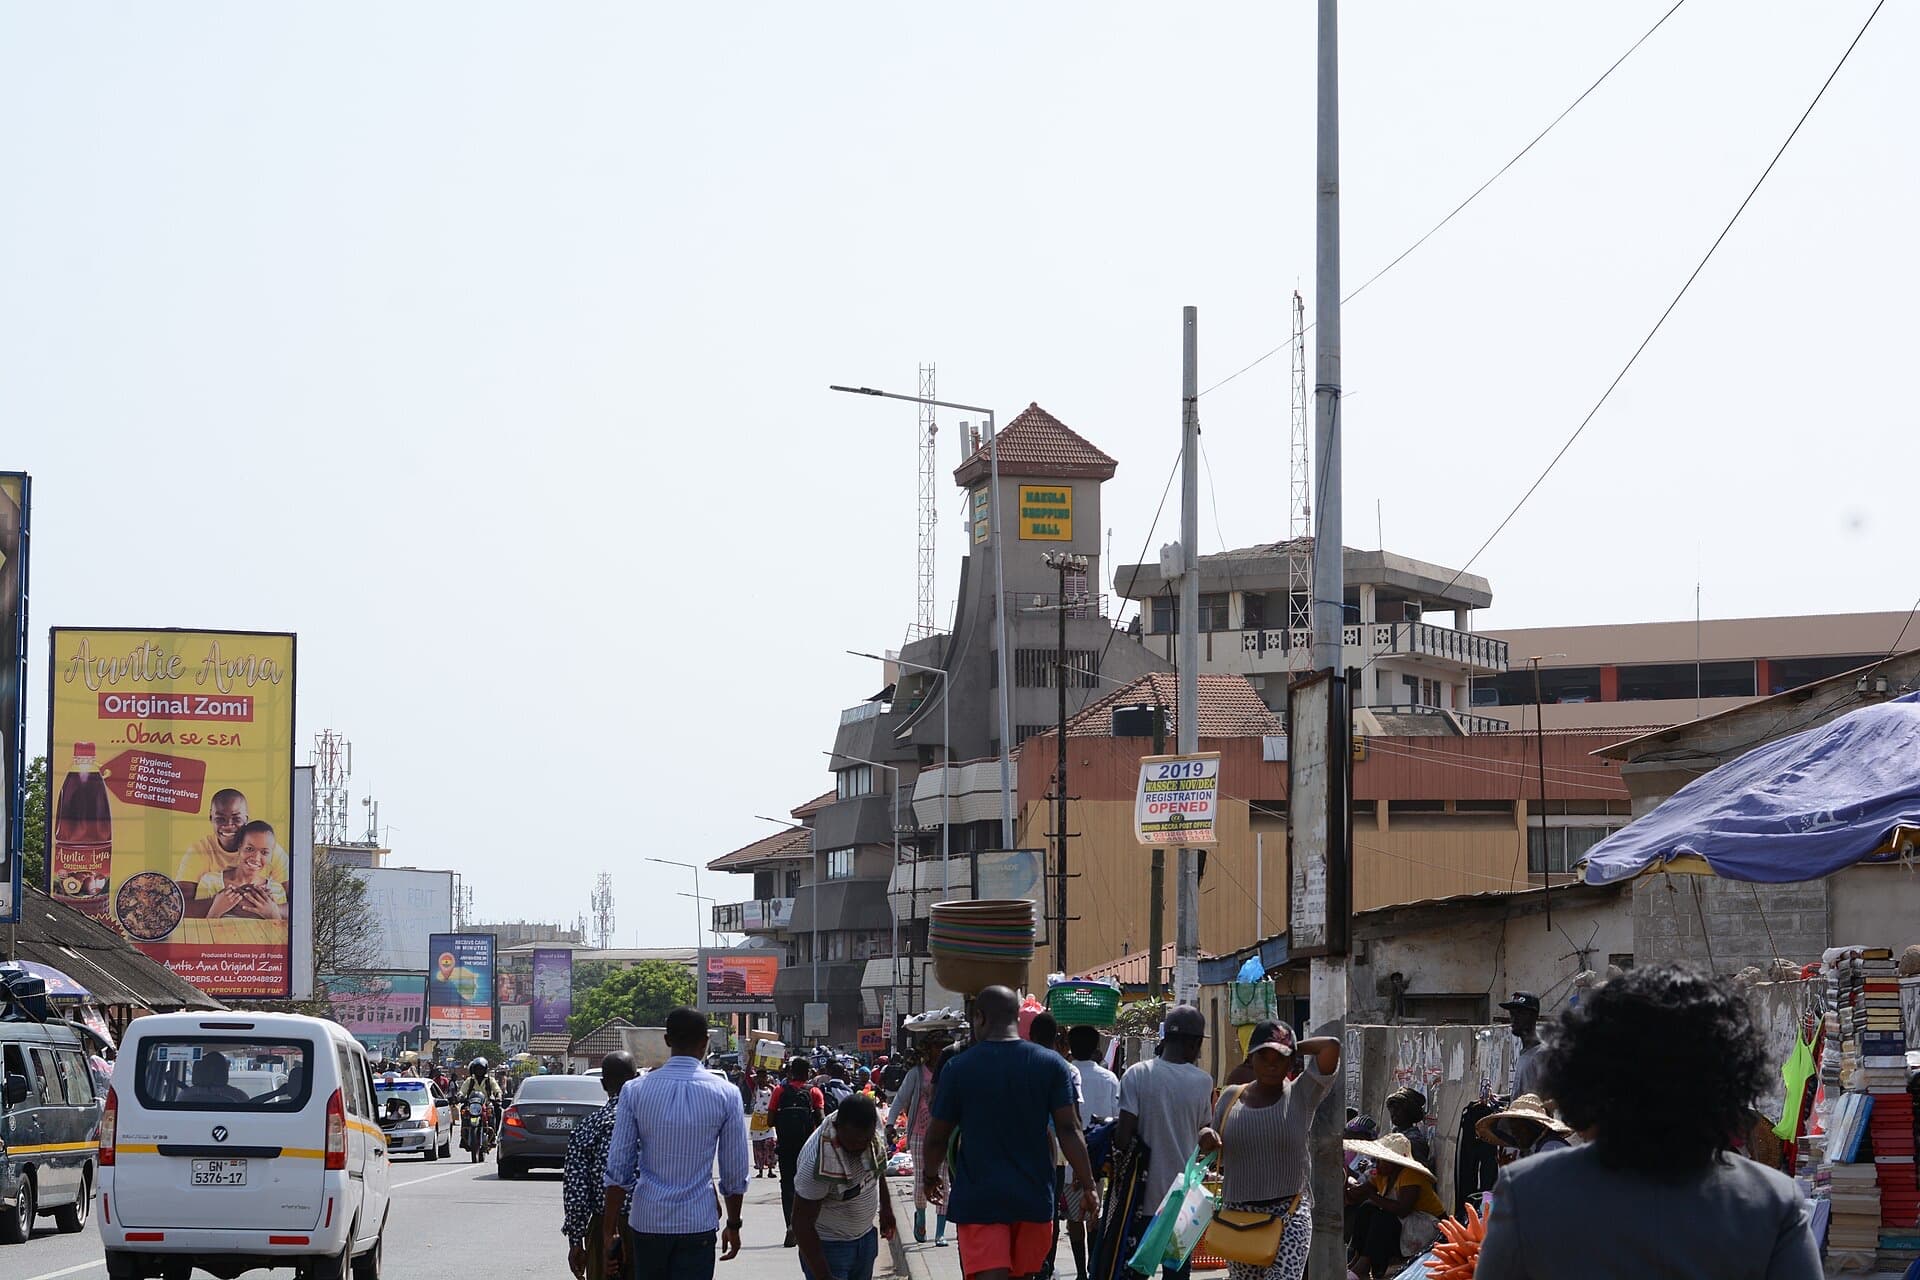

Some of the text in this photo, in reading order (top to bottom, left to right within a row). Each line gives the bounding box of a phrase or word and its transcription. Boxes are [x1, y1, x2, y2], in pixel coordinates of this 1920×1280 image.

[1032, 523, 1060, 535] MALL
[64, 636, 284, 694] Auntie Ama
[104, 695, 248, 718] Original Zomi
[180, 732, 203, 745] se
[139, 756, 173, 769] Hygienic
[138, 766, 181, 778] FDA tested
[1158, 762, 1204, 779] 2019
[136, 774, 169, 785] No color
[135, 782, 199, 799] No preservatives
[1145, 780, 1178, 792] WASSCE
[134, 791, 176, 804] Great taste
[1145, 791, 1212, 803] REGISTRATION
[1148, 801, 1208, 814] OPENED
[1161, 823, 1178, 831] ACCRA
[1193, 821, 1211, 829] OFFICE
[163, 959, 283, 975] Auntie Ama Original Zomi
[213, 975, 236, 983] CALL:
[209, 1161, 223, 1172] GN
[195, 1172, 242, 1184] 5376-17
